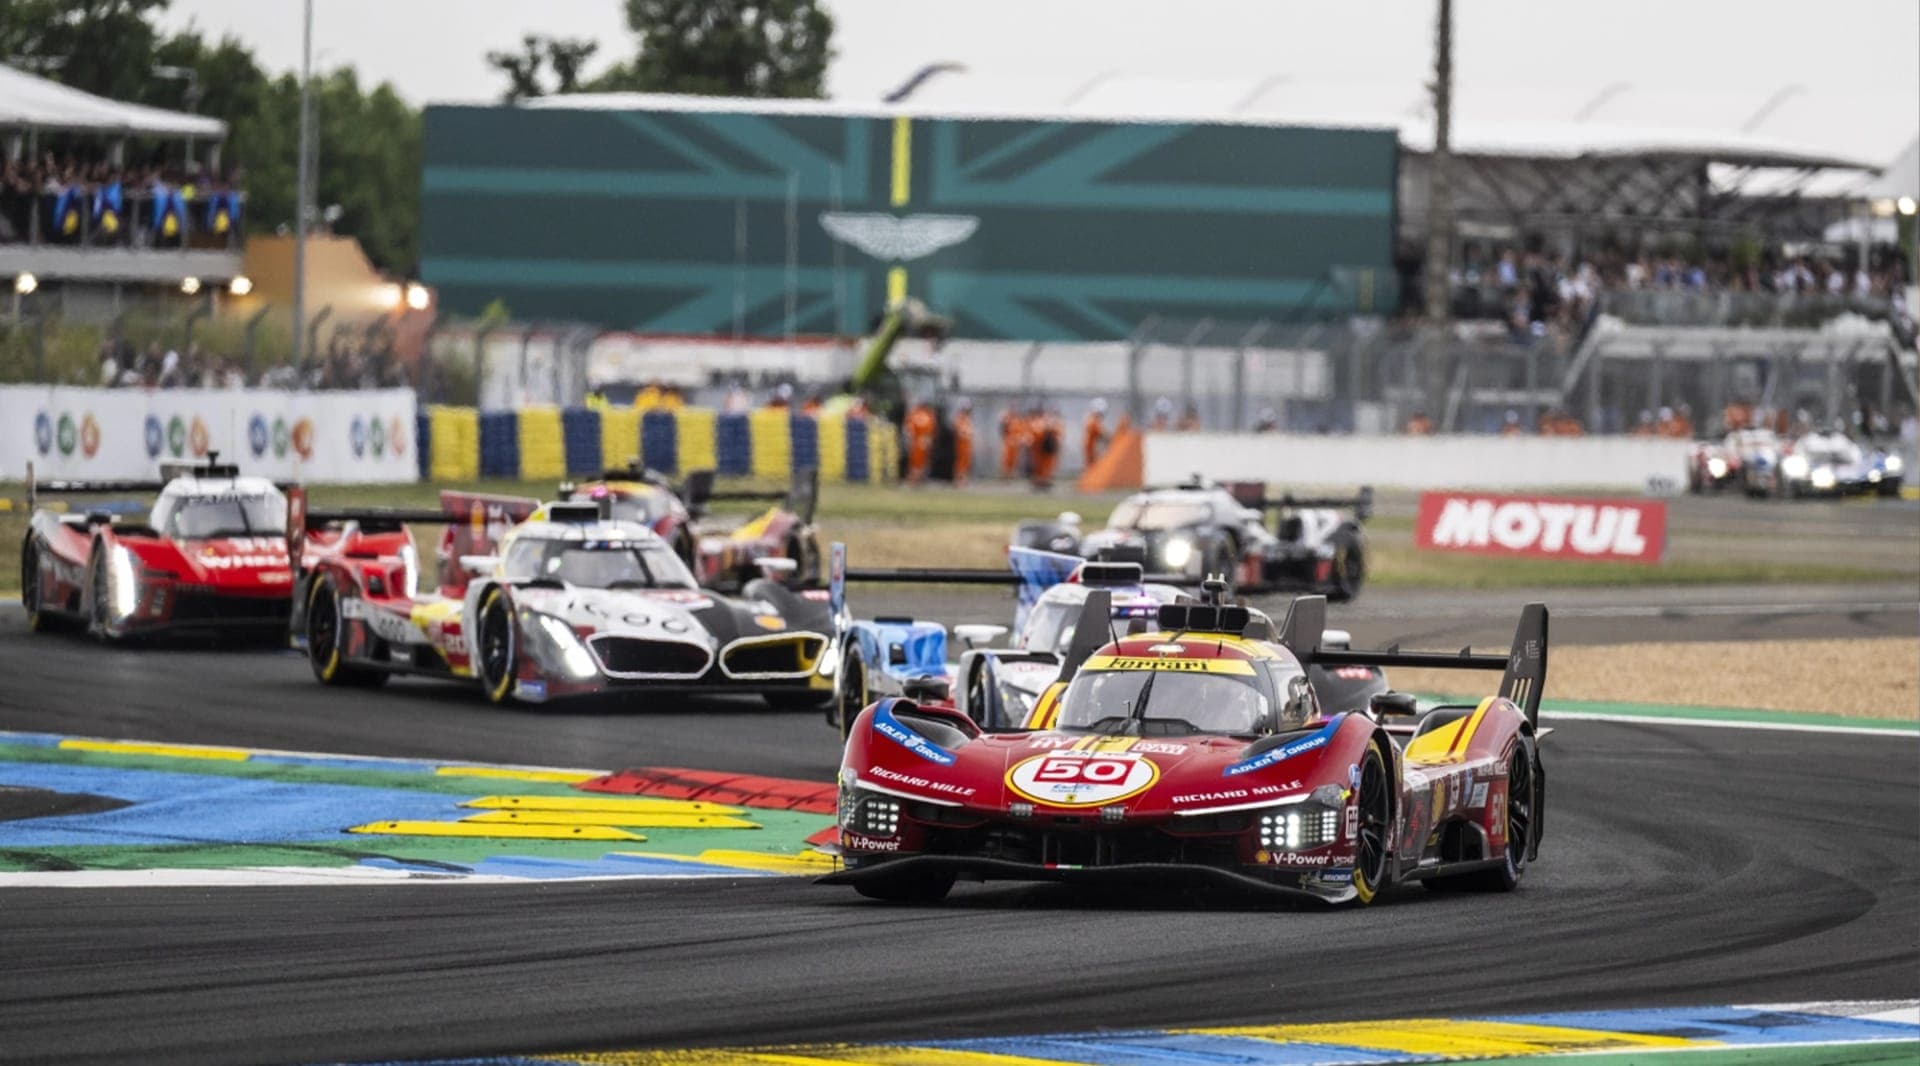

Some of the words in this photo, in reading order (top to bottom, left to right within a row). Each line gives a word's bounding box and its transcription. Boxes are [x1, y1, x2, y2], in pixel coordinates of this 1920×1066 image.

[1432, 498, 1646, 555] MOTUL
[1109, 658, 1208, 671] Ferrari
[874, 722, 907, 741] ADLER
[915, 744, 951, 763] GROUP
[1230, 758, 1270, 775] ADLER
[1286, 737, 1326, 755] GROUP
[869, 766, 929, 786] RICHARD
[930, 781, 976, 796] MILLE
[1040, 759, 1128, 782] 50
[1172, 789, 1248, 804] RICHARD
[1252, 780, 1303, 796] MILLE
[851, 837, 900, 850] V-Power
[1273, 852, 1329, 865] V-Power
